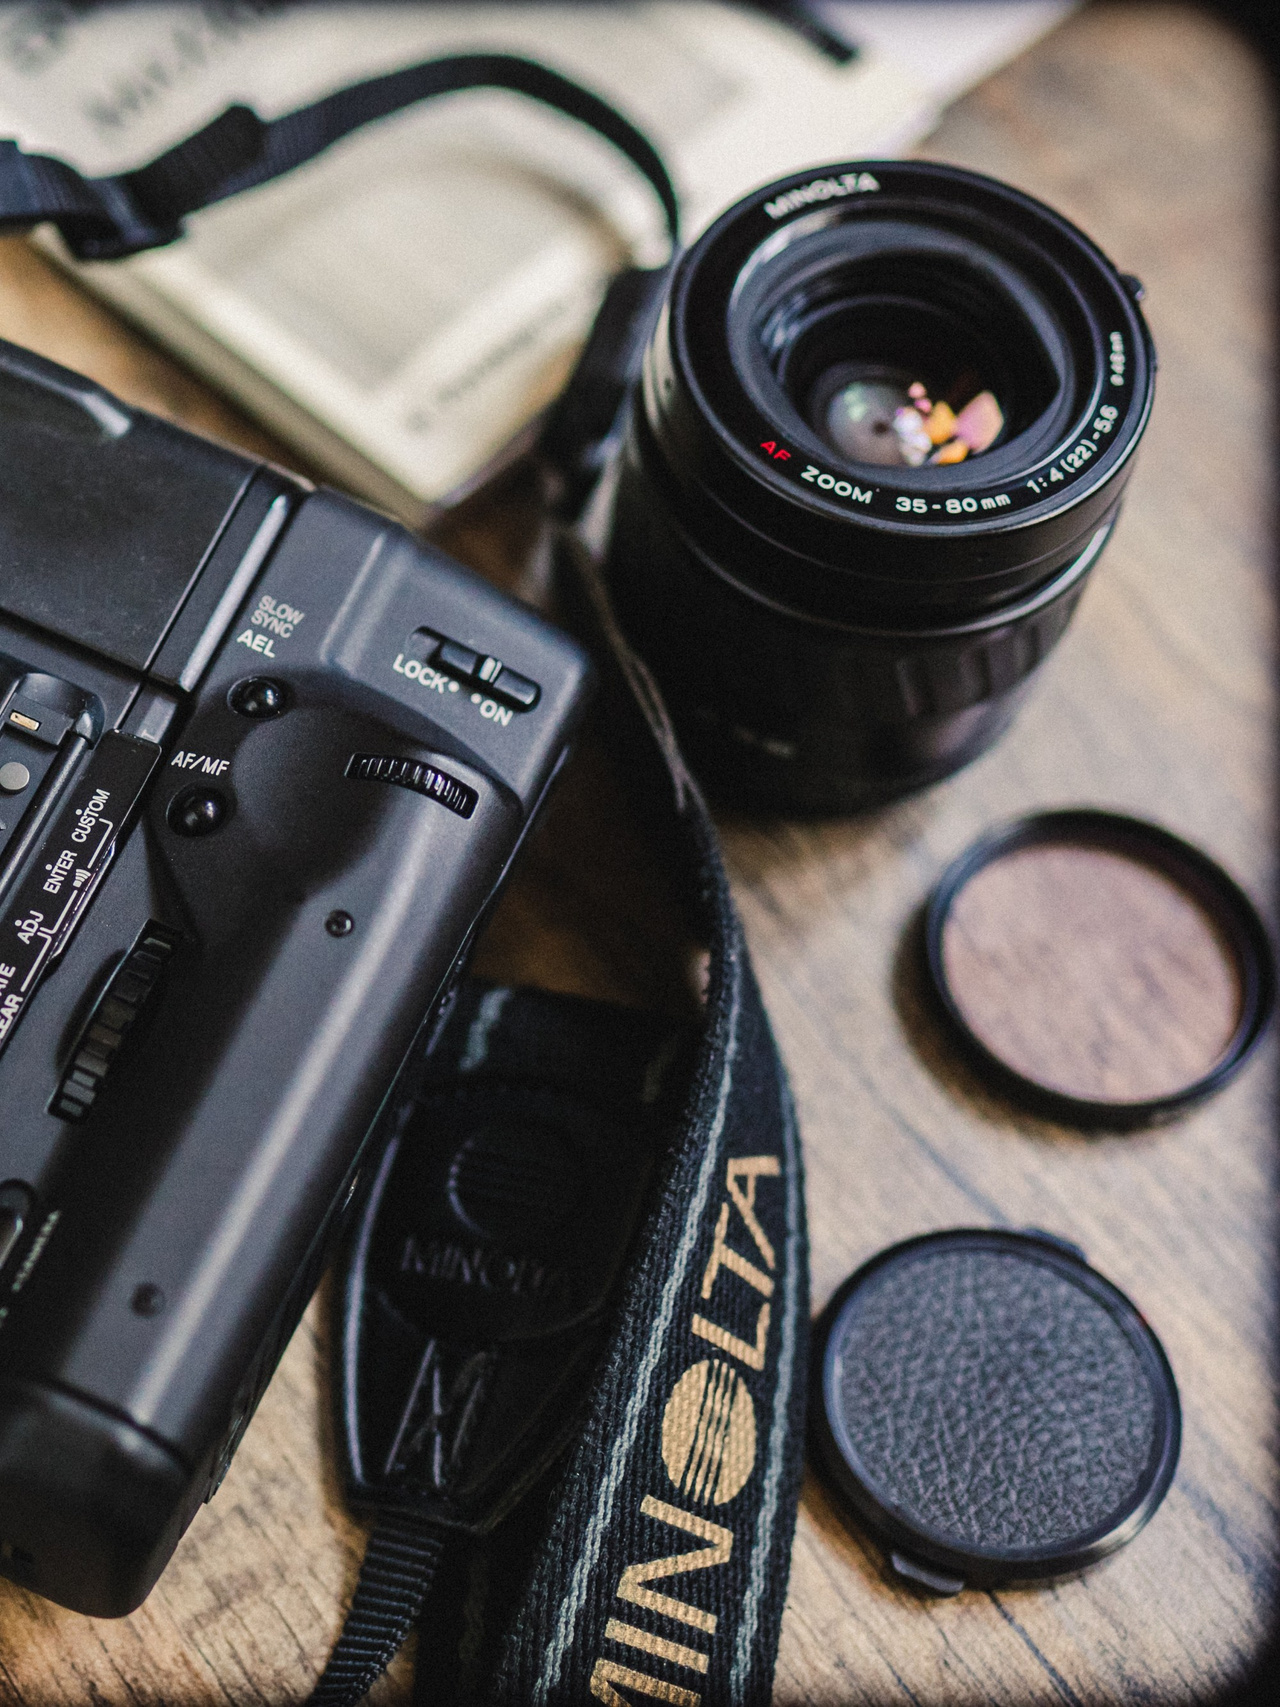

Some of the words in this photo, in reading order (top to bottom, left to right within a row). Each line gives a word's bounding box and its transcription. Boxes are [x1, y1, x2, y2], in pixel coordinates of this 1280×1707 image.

[764, 171, 881, 219] MINOLTA
[760, 439, 791, 464] AF
[800, 465, 874, 506] ZOOM
[251, 610, 295, 638] SYNC
[259, 596, 303, 626] SLOW
[236, 629, 278, 658] AEL
[393, 653, 448, 694] LOCK
[477, 697, 514, 726] ON
[171, 751, 230, 776] AF/MF
[72, 788, 111, 843] CUSTOM
[43, 849, 77, 894] ENTER
[17, 910, 44, 944] ADJ
